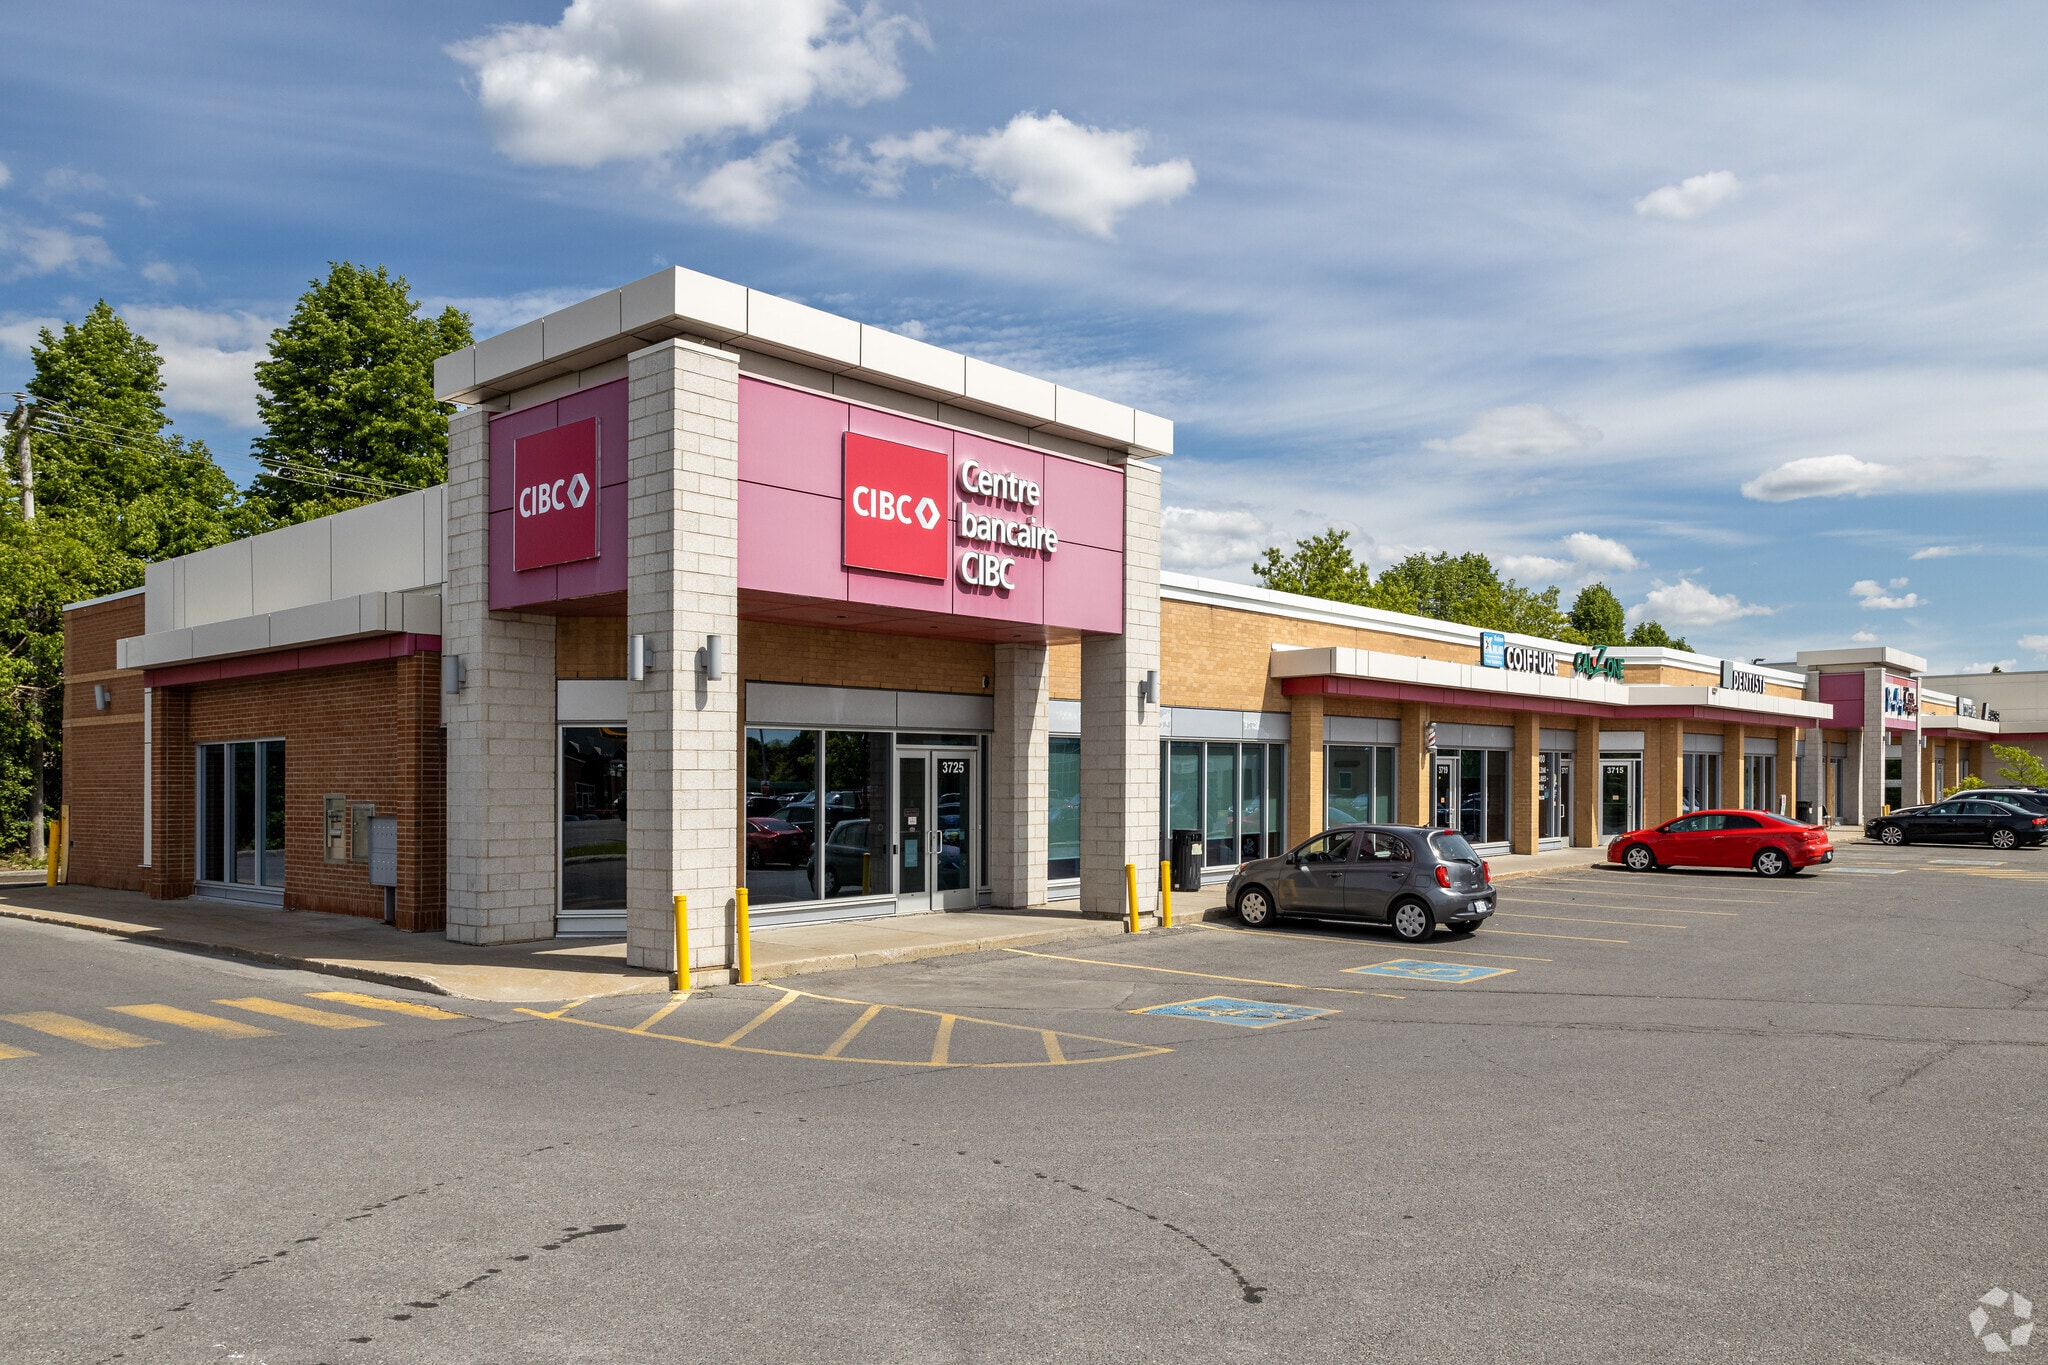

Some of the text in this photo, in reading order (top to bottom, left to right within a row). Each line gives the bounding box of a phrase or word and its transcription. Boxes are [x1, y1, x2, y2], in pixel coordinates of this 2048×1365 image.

[519, 478, 566, 518] CIBC
[959, 459, 1040, 506] Centre
[852, 485, 912, 525] CIBC
[958, 502, 1059, 553] bancaire
[959, 551, 1016, 590] CIBC
[1505, 646, 1559, 675] COIFFURE
[942, 761, 965, 774] 3725
[1606, 766, 1625, 774] 3715
